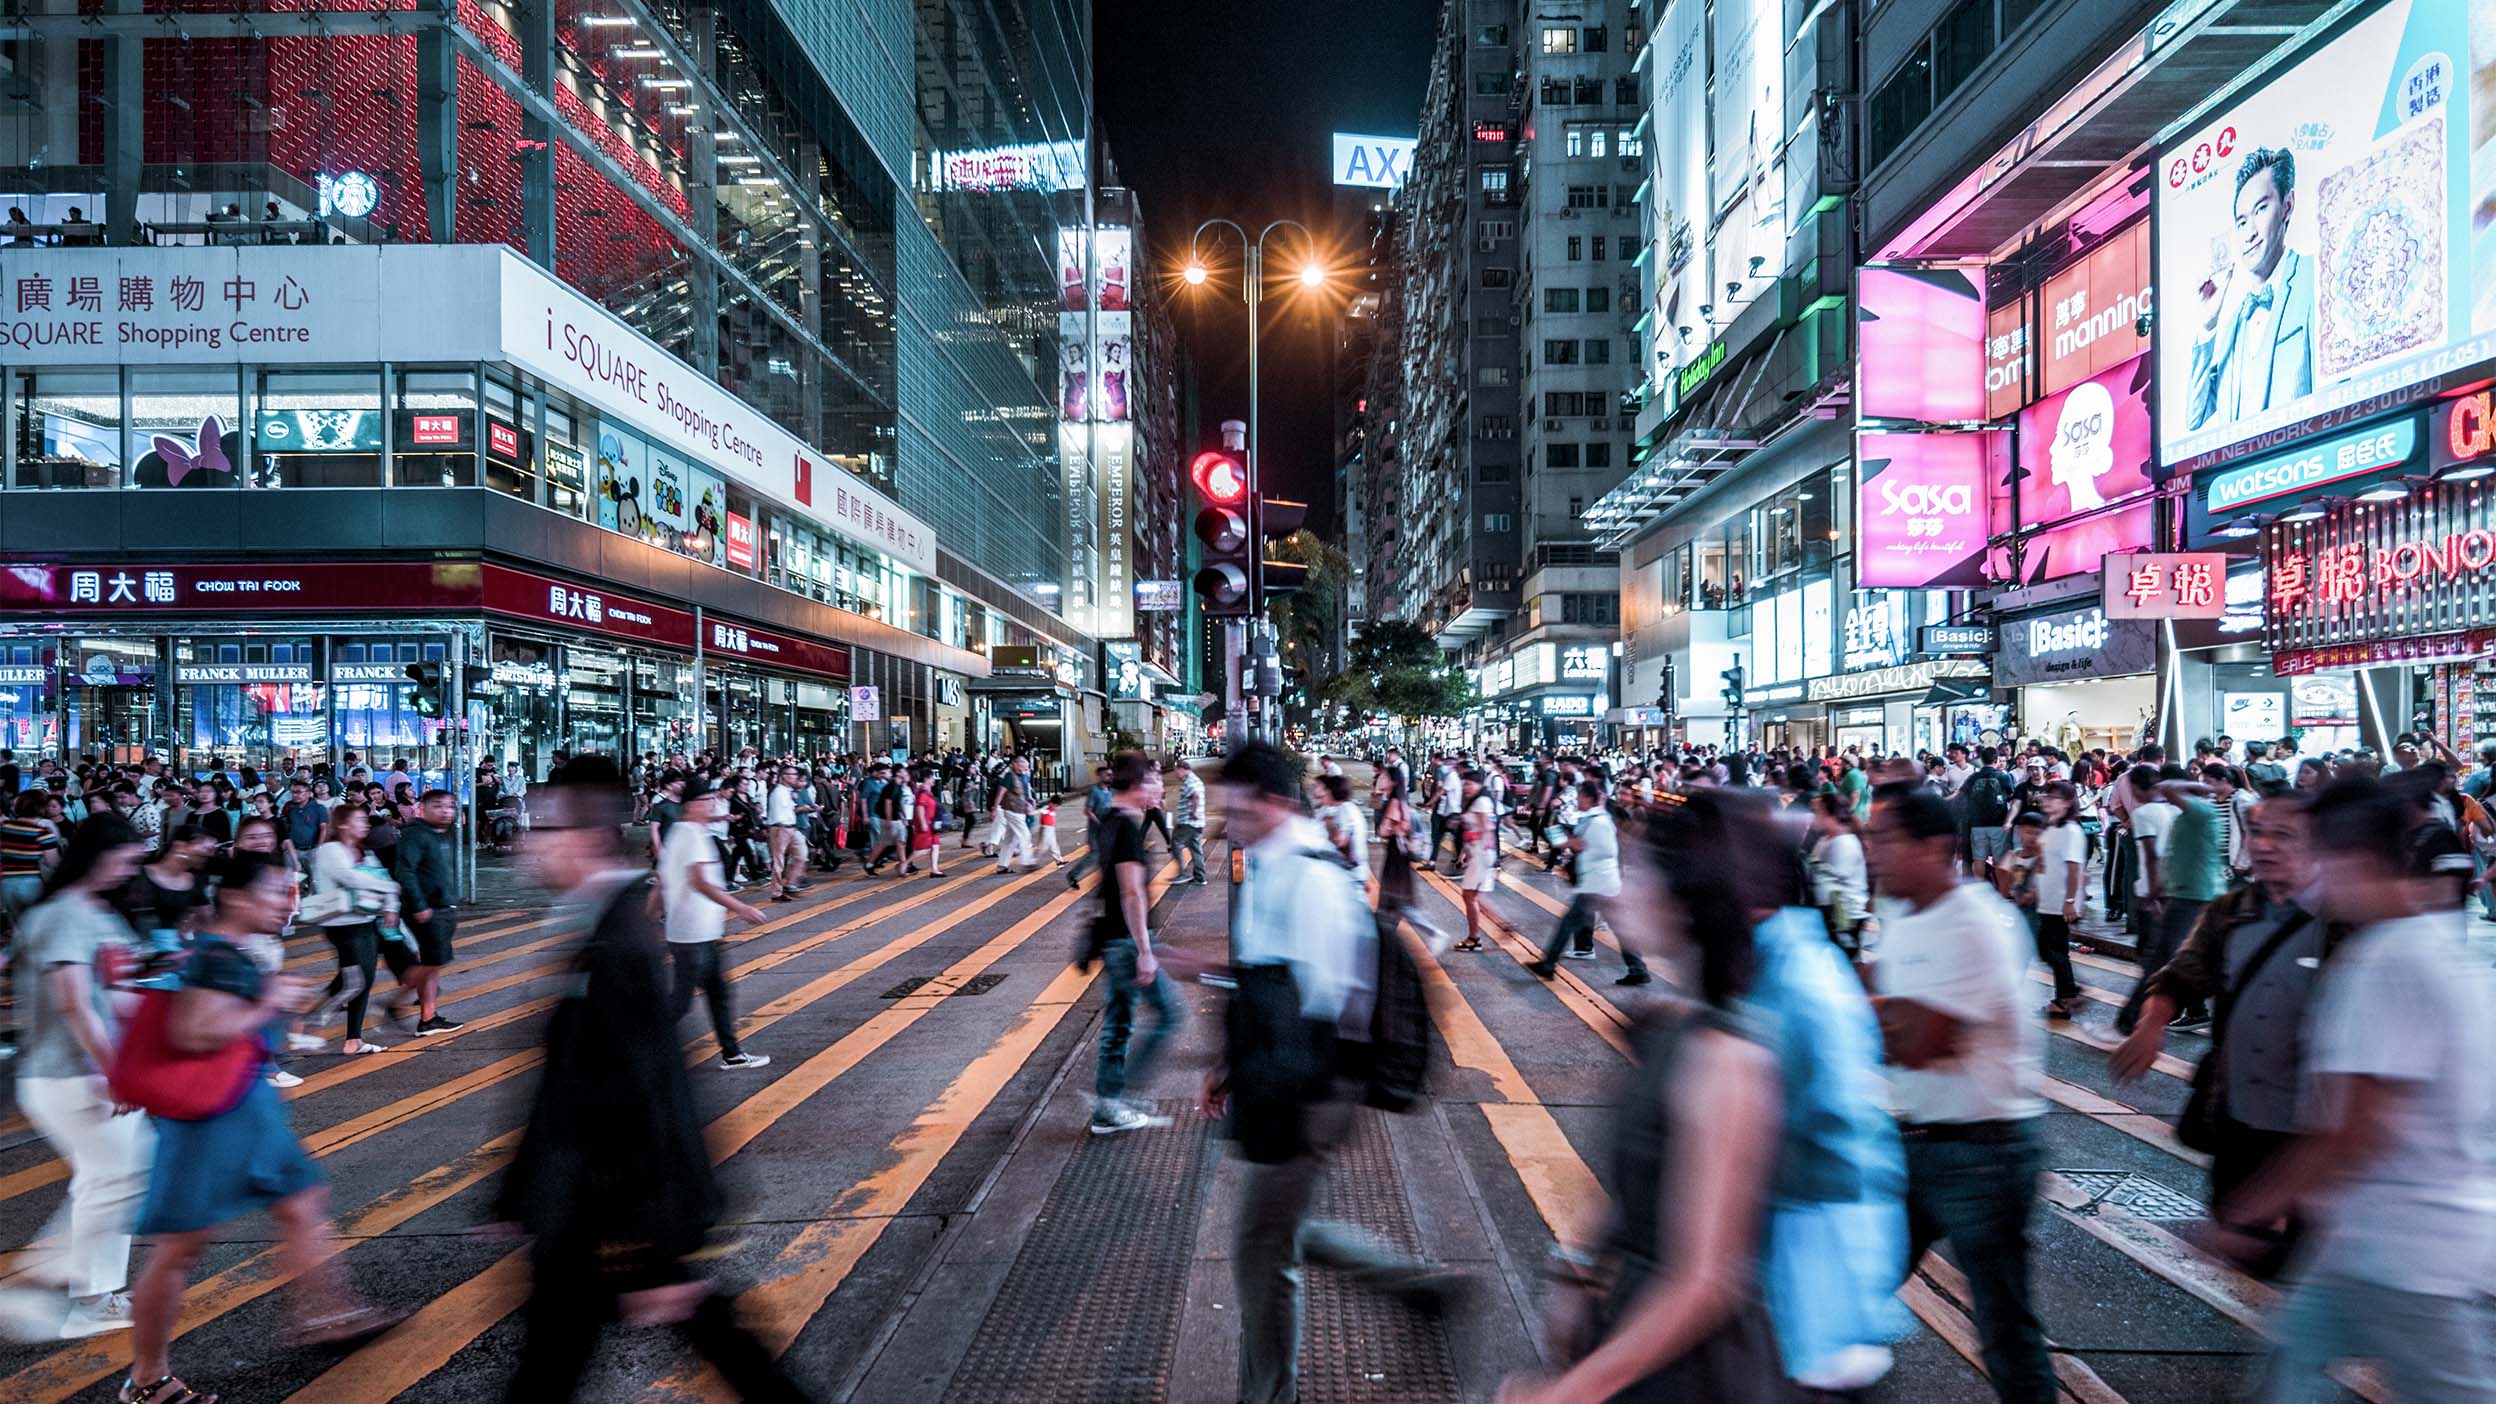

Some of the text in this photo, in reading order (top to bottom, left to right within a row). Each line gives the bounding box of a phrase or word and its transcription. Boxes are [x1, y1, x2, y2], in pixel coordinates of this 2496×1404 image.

[17, 272, 310, 313] 廣場購物中心
[0, 321, 310, 349] SQUARE Shopping Centre
[1681, 341, 1725, 397] Holiday Inn
[547, 307, 763, 467] i SQUARE Shopping Centre
[2192, 452, 2216, 471] JM
[2221, 419, 2314, 462] NETWORK
[2321, 376, 2442, 431] 27230020
[2219, 432, 2397, 501] watsons 屈臣氏
[1111, 455, 1123, 529] EMPEROR
[2166, 474, 2191, 493] JM
[731, 520, 752, 545] 周大
[70, 571, 301, 603] 周大福 CHOW TAI FOOK
[550, 585, 602, 623] 周大福
[713, 624, 748, 653] 周大福
[179, 667, 309, 681] FRANCK MULLER
[335, 666, 396, 680] FRANCK
[2046, 660, 2070, 673] design
[2281, 654, 2316, 676] SALE
[942, 678, 961, 707] M&S
